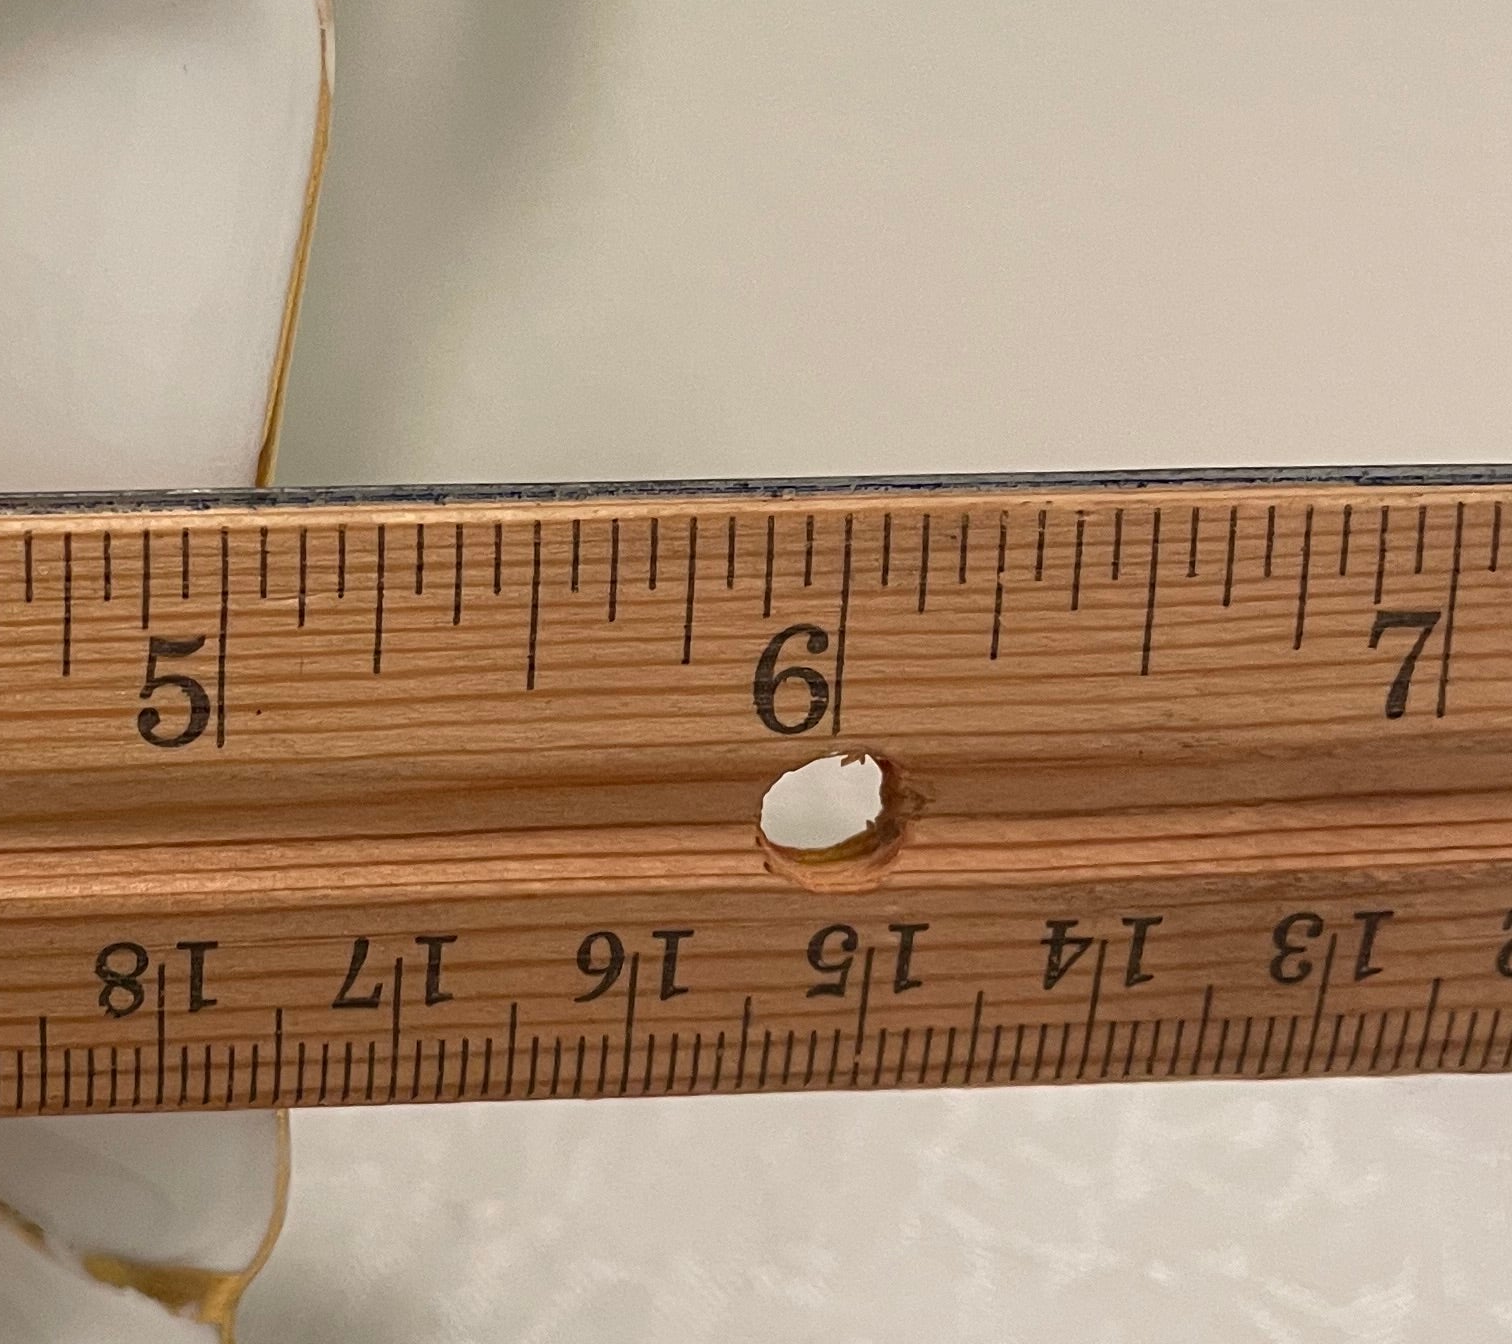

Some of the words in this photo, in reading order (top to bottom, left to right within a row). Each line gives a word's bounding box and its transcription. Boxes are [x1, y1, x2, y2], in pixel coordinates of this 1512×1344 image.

[137, 635, 212, 748] 5
[753, 623, 831, 735] 6
[1368, 610, 1442, 719] 7
[94, 940, 219, 1018] 18
[332, 935, 458, 1009] 17
[575, 929, 694, 1003] 16
[806, 922, 930, 998] 15
[1041, 916, 1163, 990] 14
[1269, 910, 1394, 984] 13
